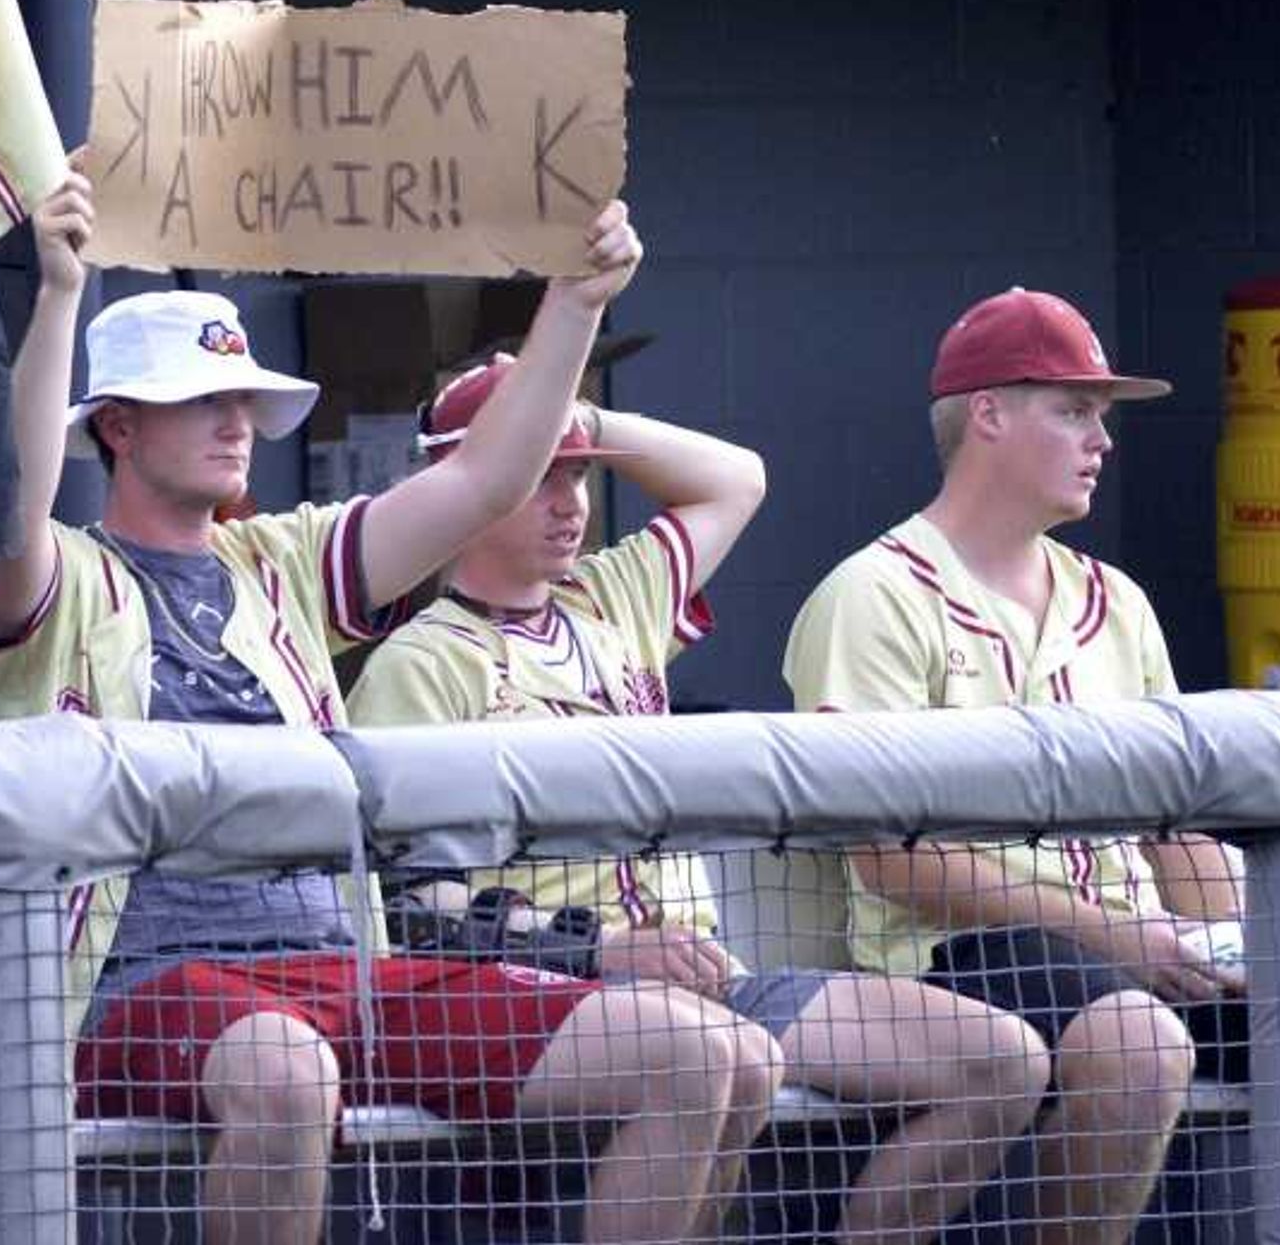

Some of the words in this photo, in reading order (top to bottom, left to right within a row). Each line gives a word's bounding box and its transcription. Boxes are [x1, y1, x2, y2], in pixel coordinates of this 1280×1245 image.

[167, 22, 273, 140] THROW
[291, 40, 488, 131] HIM
[160, 148, 198, 248] A
[235, 157, 462, 234] CHAIR!!
[533, 97, 602, 222] K
